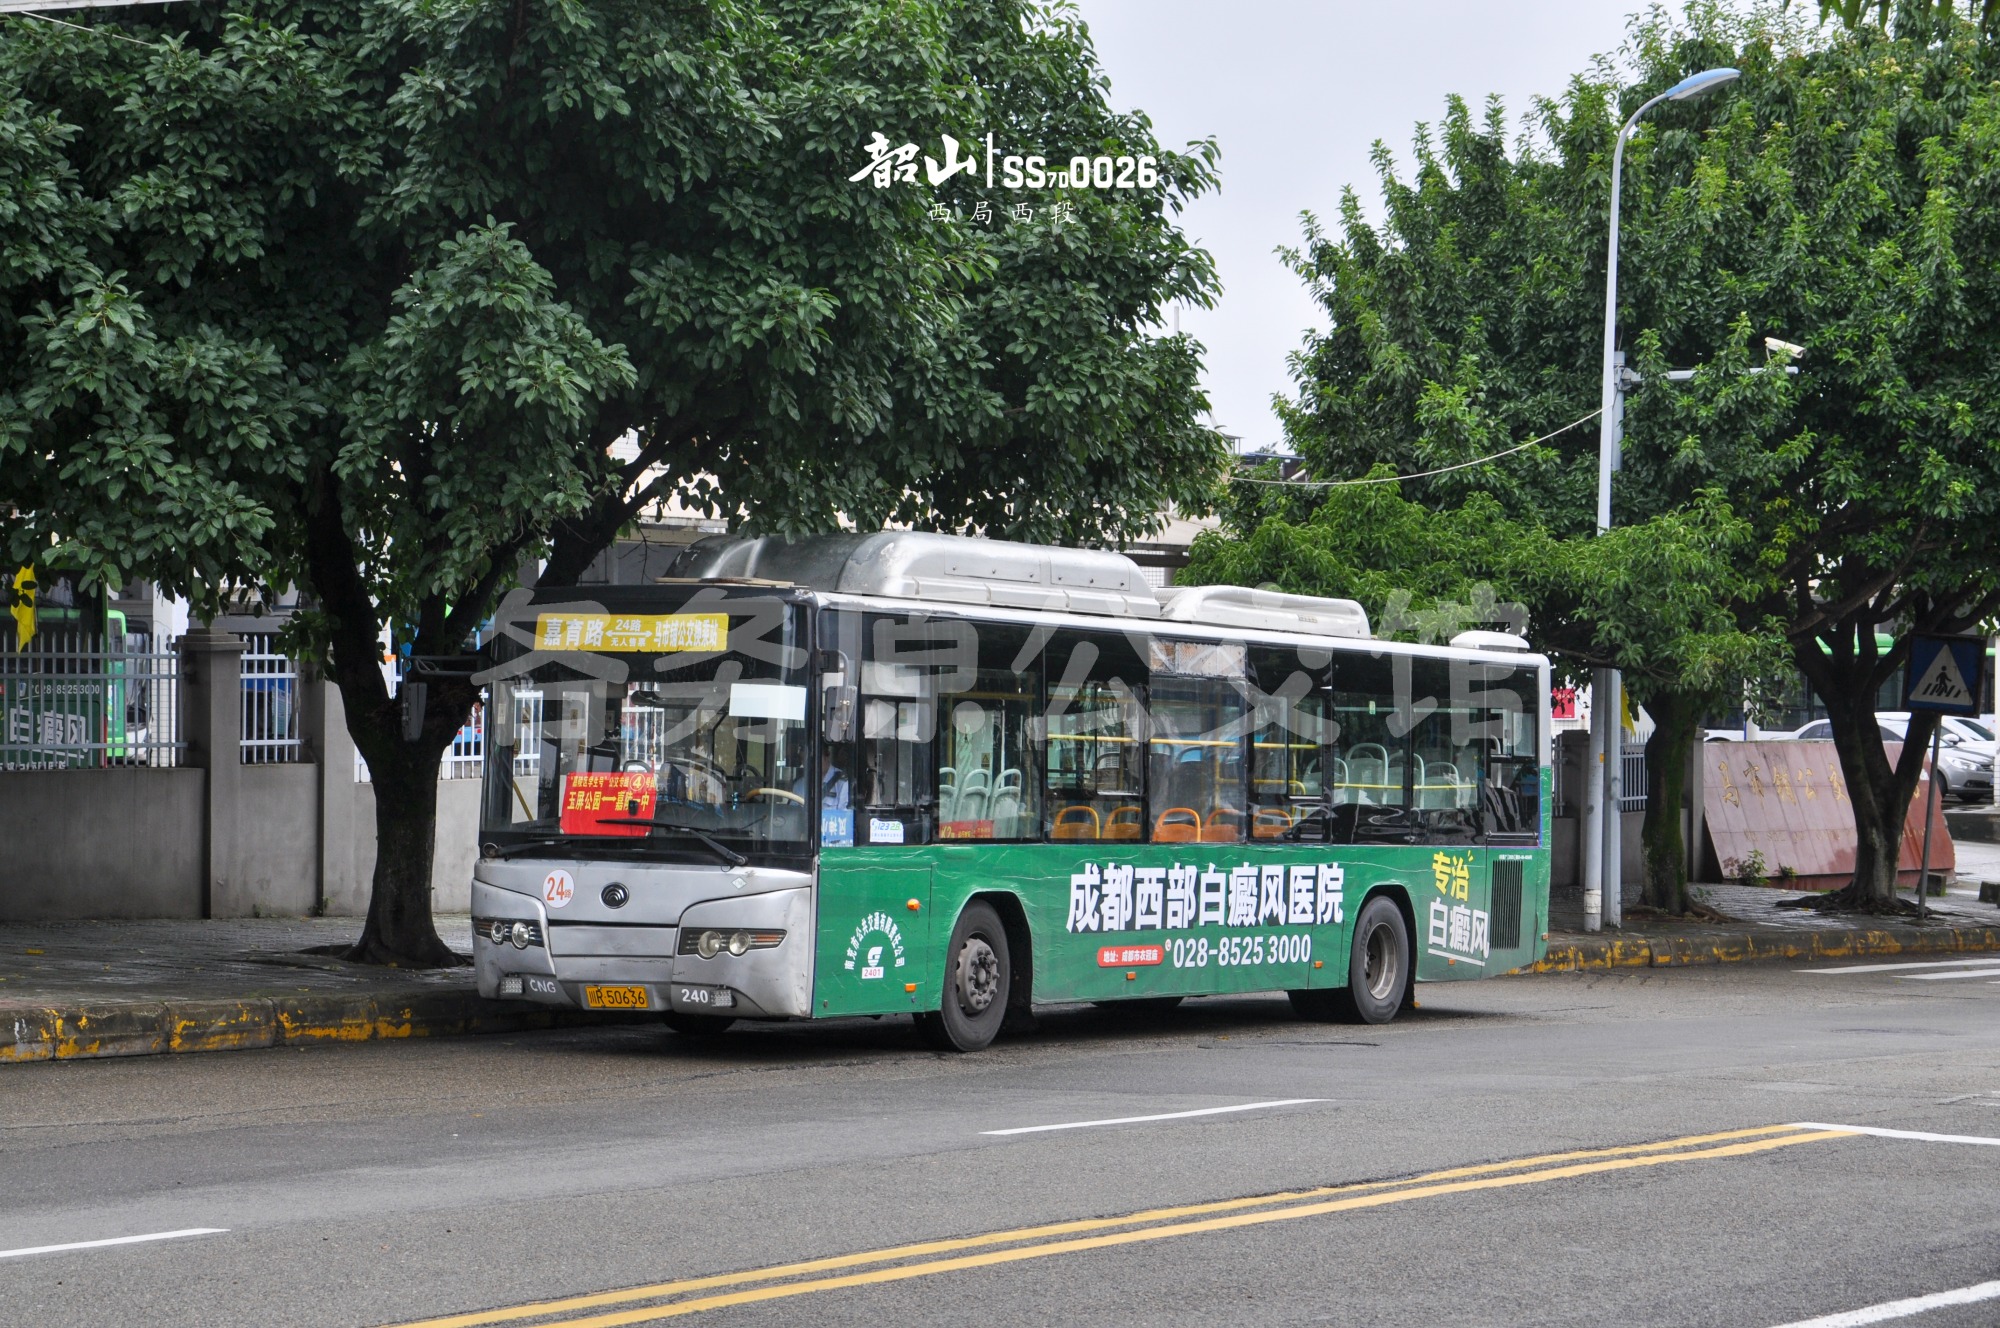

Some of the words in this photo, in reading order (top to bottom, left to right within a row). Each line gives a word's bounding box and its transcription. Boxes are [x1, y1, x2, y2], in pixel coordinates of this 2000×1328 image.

[543, 618, 604, 647] 嘉育路
[610, 637, 647, 647] 无人售票
[1432, 850, 1473, 902] 专治
[1066, 862, 1345, 933] 成都西部白癜风医院
[1428, 897, 1490, 959] 白癜风
[529, 979, 556, 993] CNG
